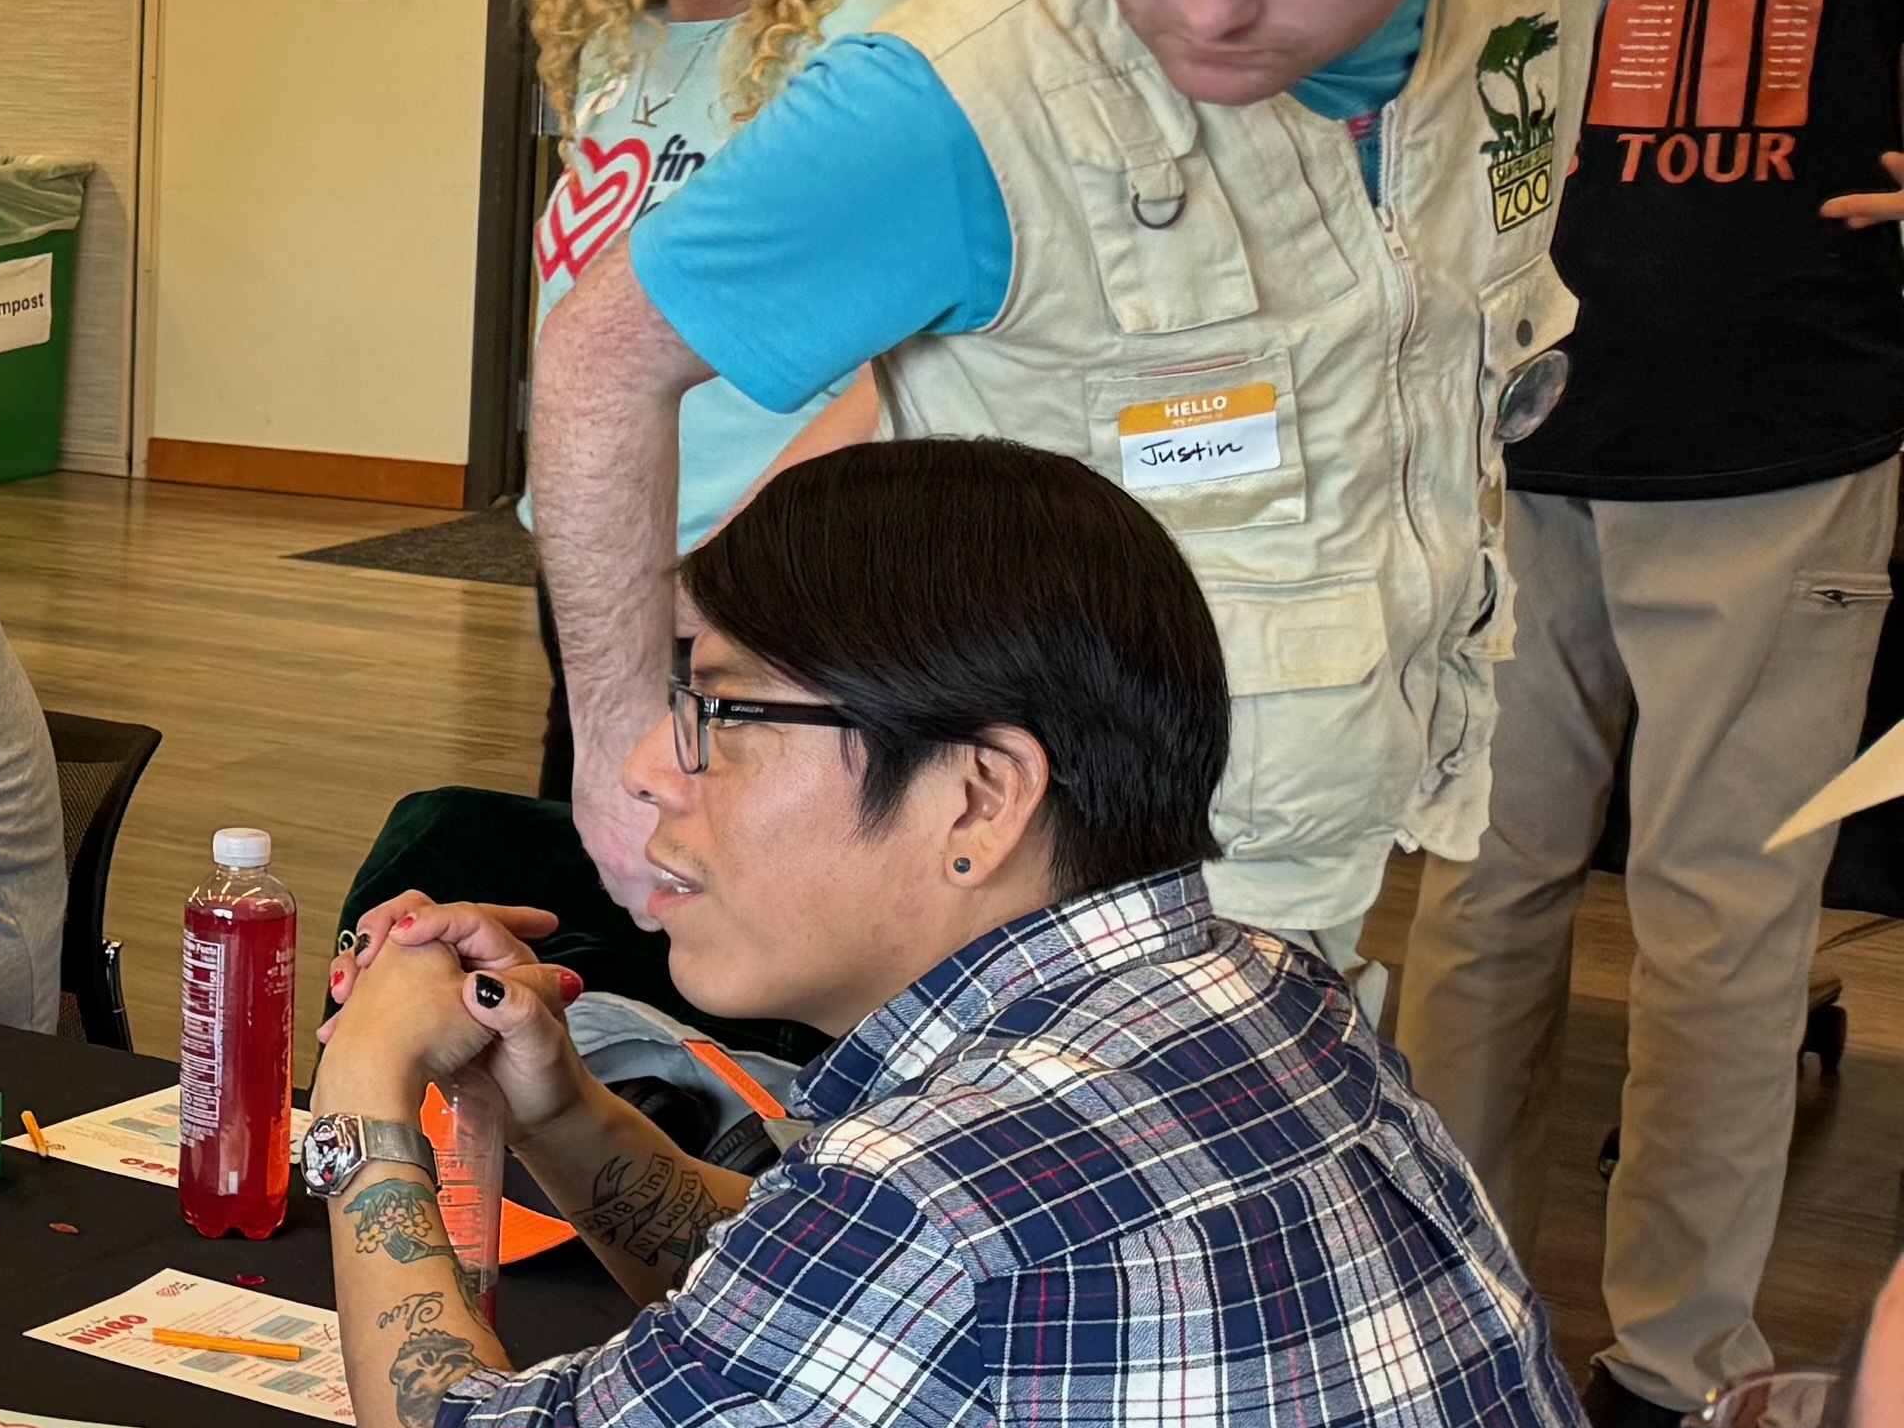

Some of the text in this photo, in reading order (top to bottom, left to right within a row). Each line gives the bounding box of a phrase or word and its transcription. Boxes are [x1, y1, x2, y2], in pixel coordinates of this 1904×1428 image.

[653, 134, 706, 182] fin
[1616, 132, 1796, 184] TOUR
[1498, 169, 1549, 225] ZOO
[1164, 395, 1228, 418] HELLO
[1140, 439, 1244, 466] Justin
[68, 1314, 149, 1345] BINGO
